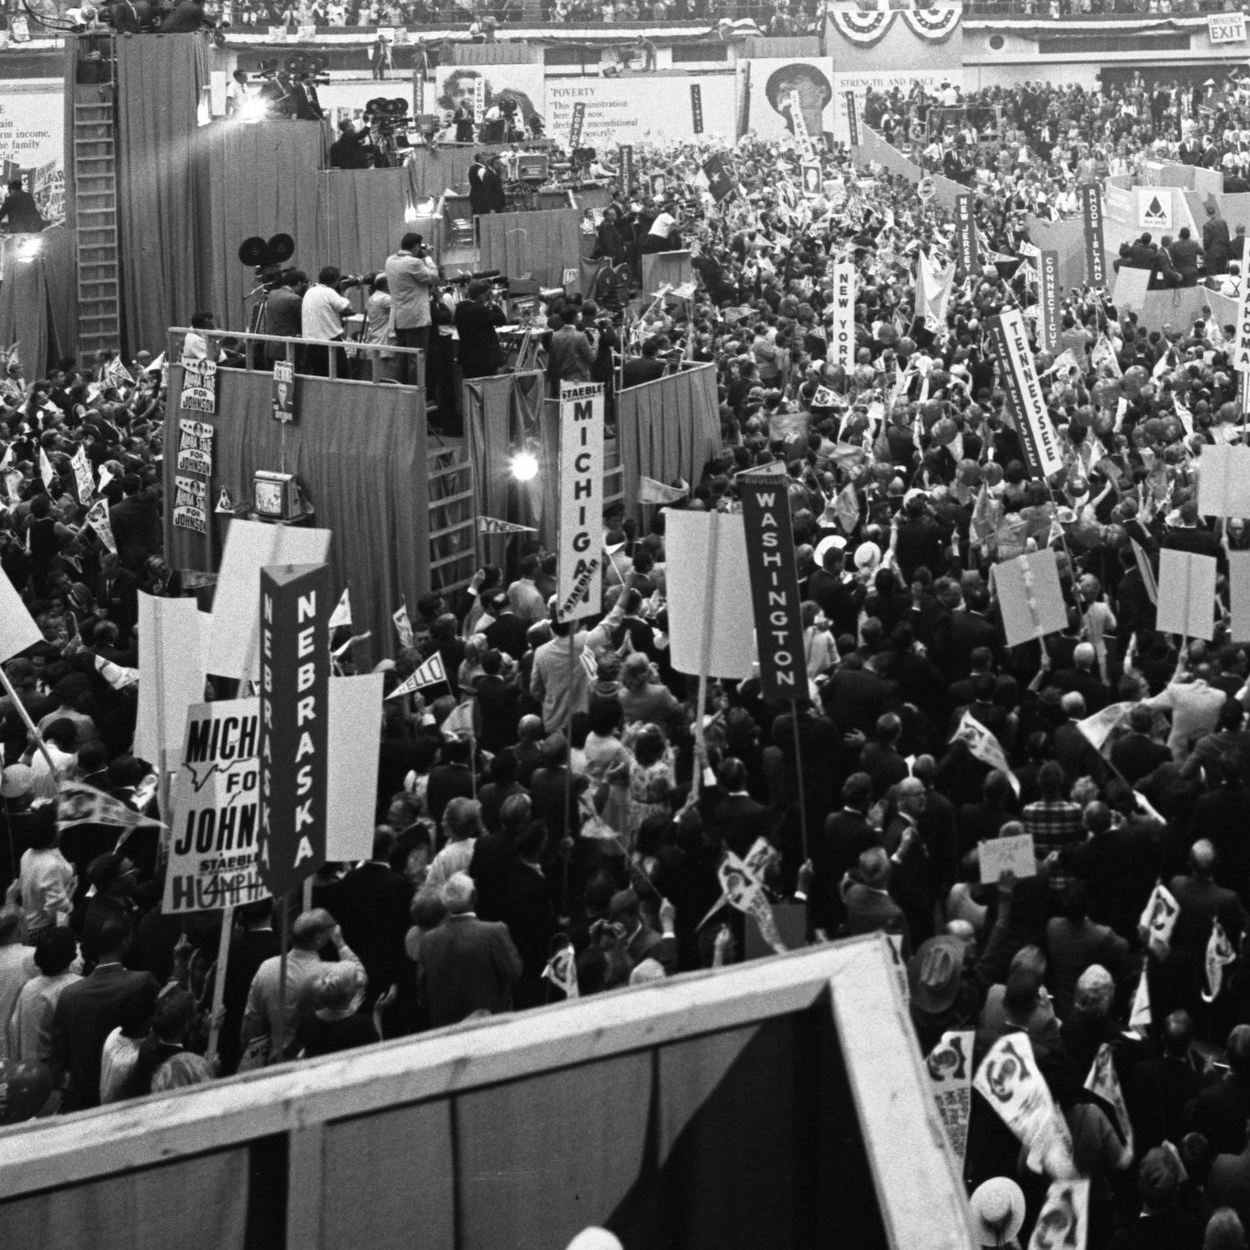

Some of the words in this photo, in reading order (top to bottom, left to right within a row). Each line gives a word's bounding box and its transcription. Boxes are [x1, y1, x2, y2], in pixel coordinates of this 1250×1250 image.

[1211, 25, 1242, 39] EXIT
[553, 88, 594, 97] POVERTY
[840, 78, 884, 87] STRENGTH
[888, 77, 906, 86] AND
[553, 111, 570, 120] here
[570, 104, 583, 147] FLORIDA
[587, 118, 638, 128] unconditional
[794, 113, 811, 153] TEXAS
[12, 139, 41, 151] family
[959, 197, 969, 221] NEW
[1089, 188, 1099, 228] RHODE
[962, 225, 972, 272] JERSEY
[1093, 233, 1103, 280] ISLAND
[838, 273, 848, 308] NEW
[1046, 257, 1058, 348] CONNECTICUT
[838, 320, 848, 367] YORK
[182, 395, 214, 412] JOHNSON
[193, 389, 207, 397] FOR
[993, 327, 1038, 467] TENNESSEE
[1009, 321, 1056, 462] TENNESSEE
[179, 455, 211, 476] JOHNSON
[190, 451, 204, 460] FOR
[186, 508, 201, 518] FOR
[572, 400, 593, 604] MICHIGA
[756, 492, 795, 686] WASHINGTON
[264, 593, 273, 870] NEBRASKA
[294, 590, 317, 869] NEBRASKA
[226, 770, 257, 794] FO
[174, 802, 258, 856] JOHN
[200, 853, 259, 872] STAEBL
